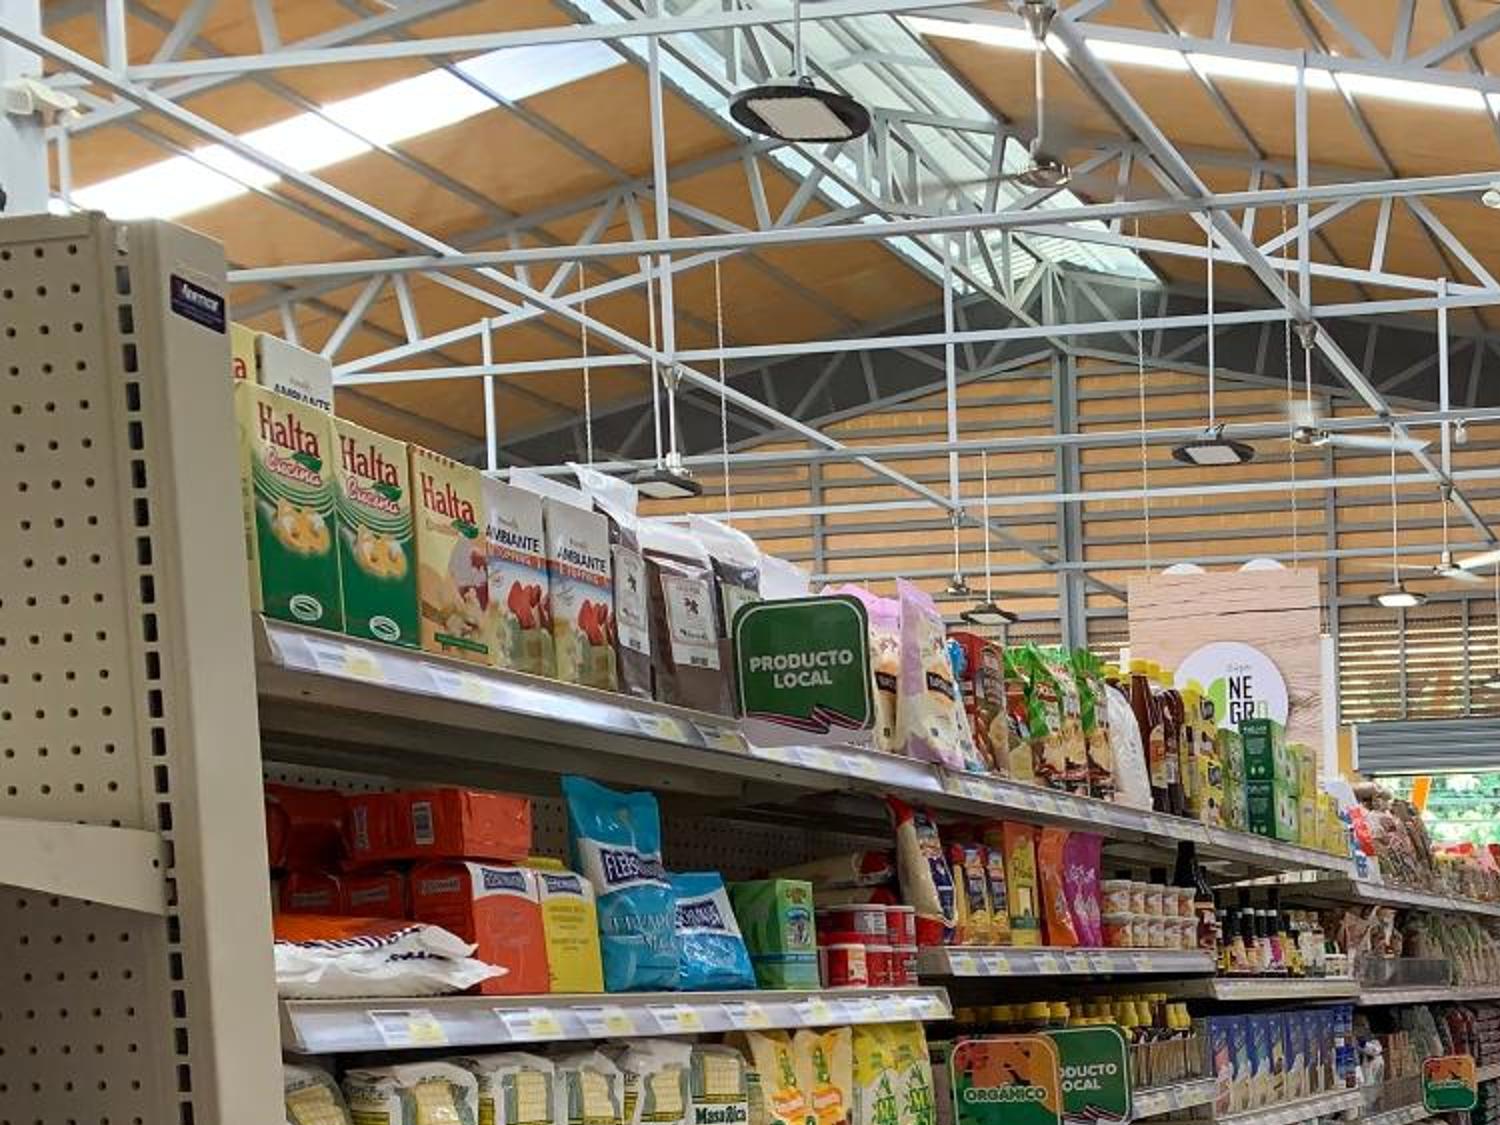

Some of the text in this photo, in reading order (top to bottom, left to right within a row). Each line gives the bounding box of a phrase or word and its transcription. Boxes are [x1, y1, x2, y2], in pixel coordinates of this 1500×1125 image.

[257, 402, 320, 458] Halta
[339, 435, 400, 487] Halta
[420, 472, 476, 524] Halta
[750, 649, 854, 672] PRODUCTO
[773, 670, 833, 689] LOCAL
[1229, 675, 1253, 699] NE
[1062, 1079, 1101, 1091] OCAL
